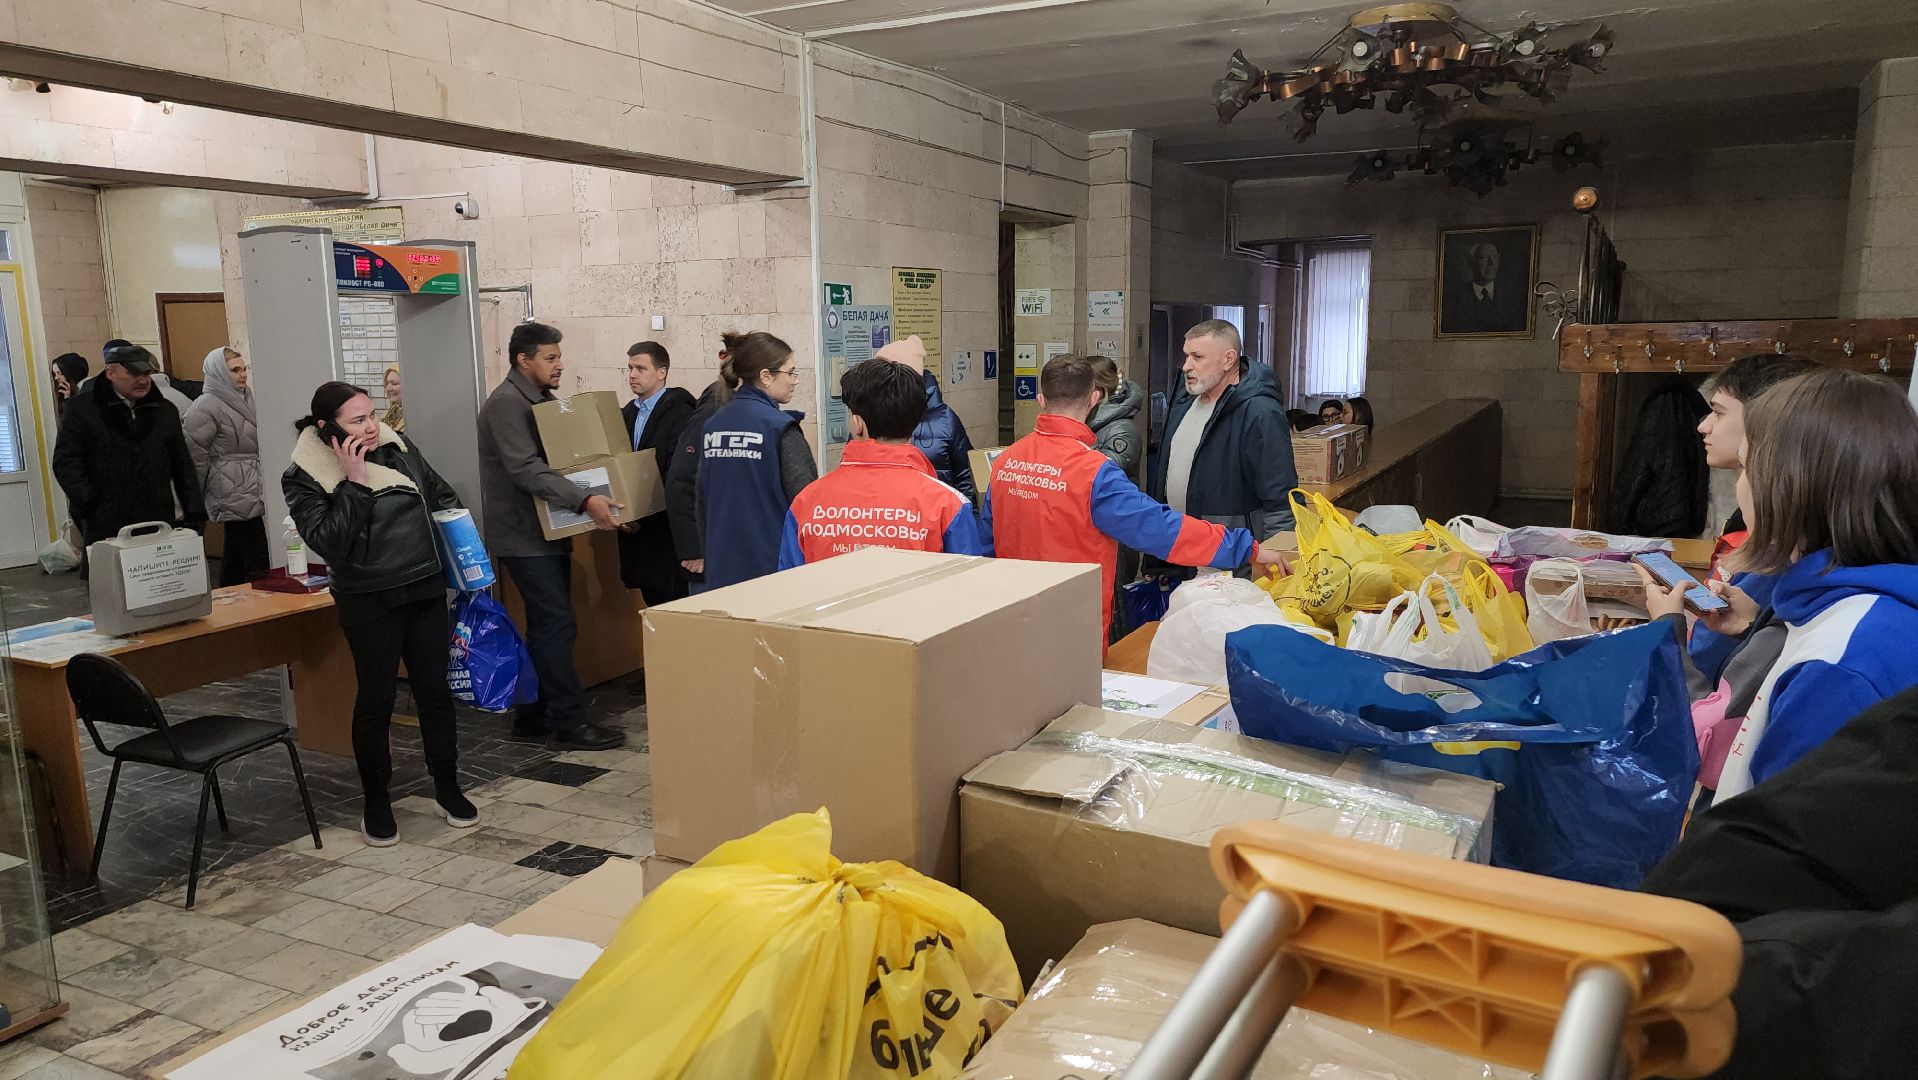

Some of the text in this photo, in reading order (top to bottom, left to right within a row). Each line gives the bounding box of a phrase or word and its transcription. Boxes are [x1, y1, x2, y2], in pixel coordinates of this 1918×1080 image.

[842, 310, 889, 323] БЕЛАЯ ДАЧА
[1021, 303, 1043, 314] WiFi
[703, 431, 764, 449] МГЕР
[1004, 458, 1062, 477] ВОЛОНТЕРЫ
[996, 469, 1067, 493] ПОДМОСКОВЬЯ
[813, 505, 921, 523] ВОЛОНТЕРЫ
[801, 522, 928, 541] ПОДМОСКОВЬЯ
[833, 543, 851, 553] МЫ
[279, 976, 399, 1049] ДОБРОЕ ДЕЛО
[289, 960, 461, 1052] НАШИМ ЗАЩИТНИКАМ
